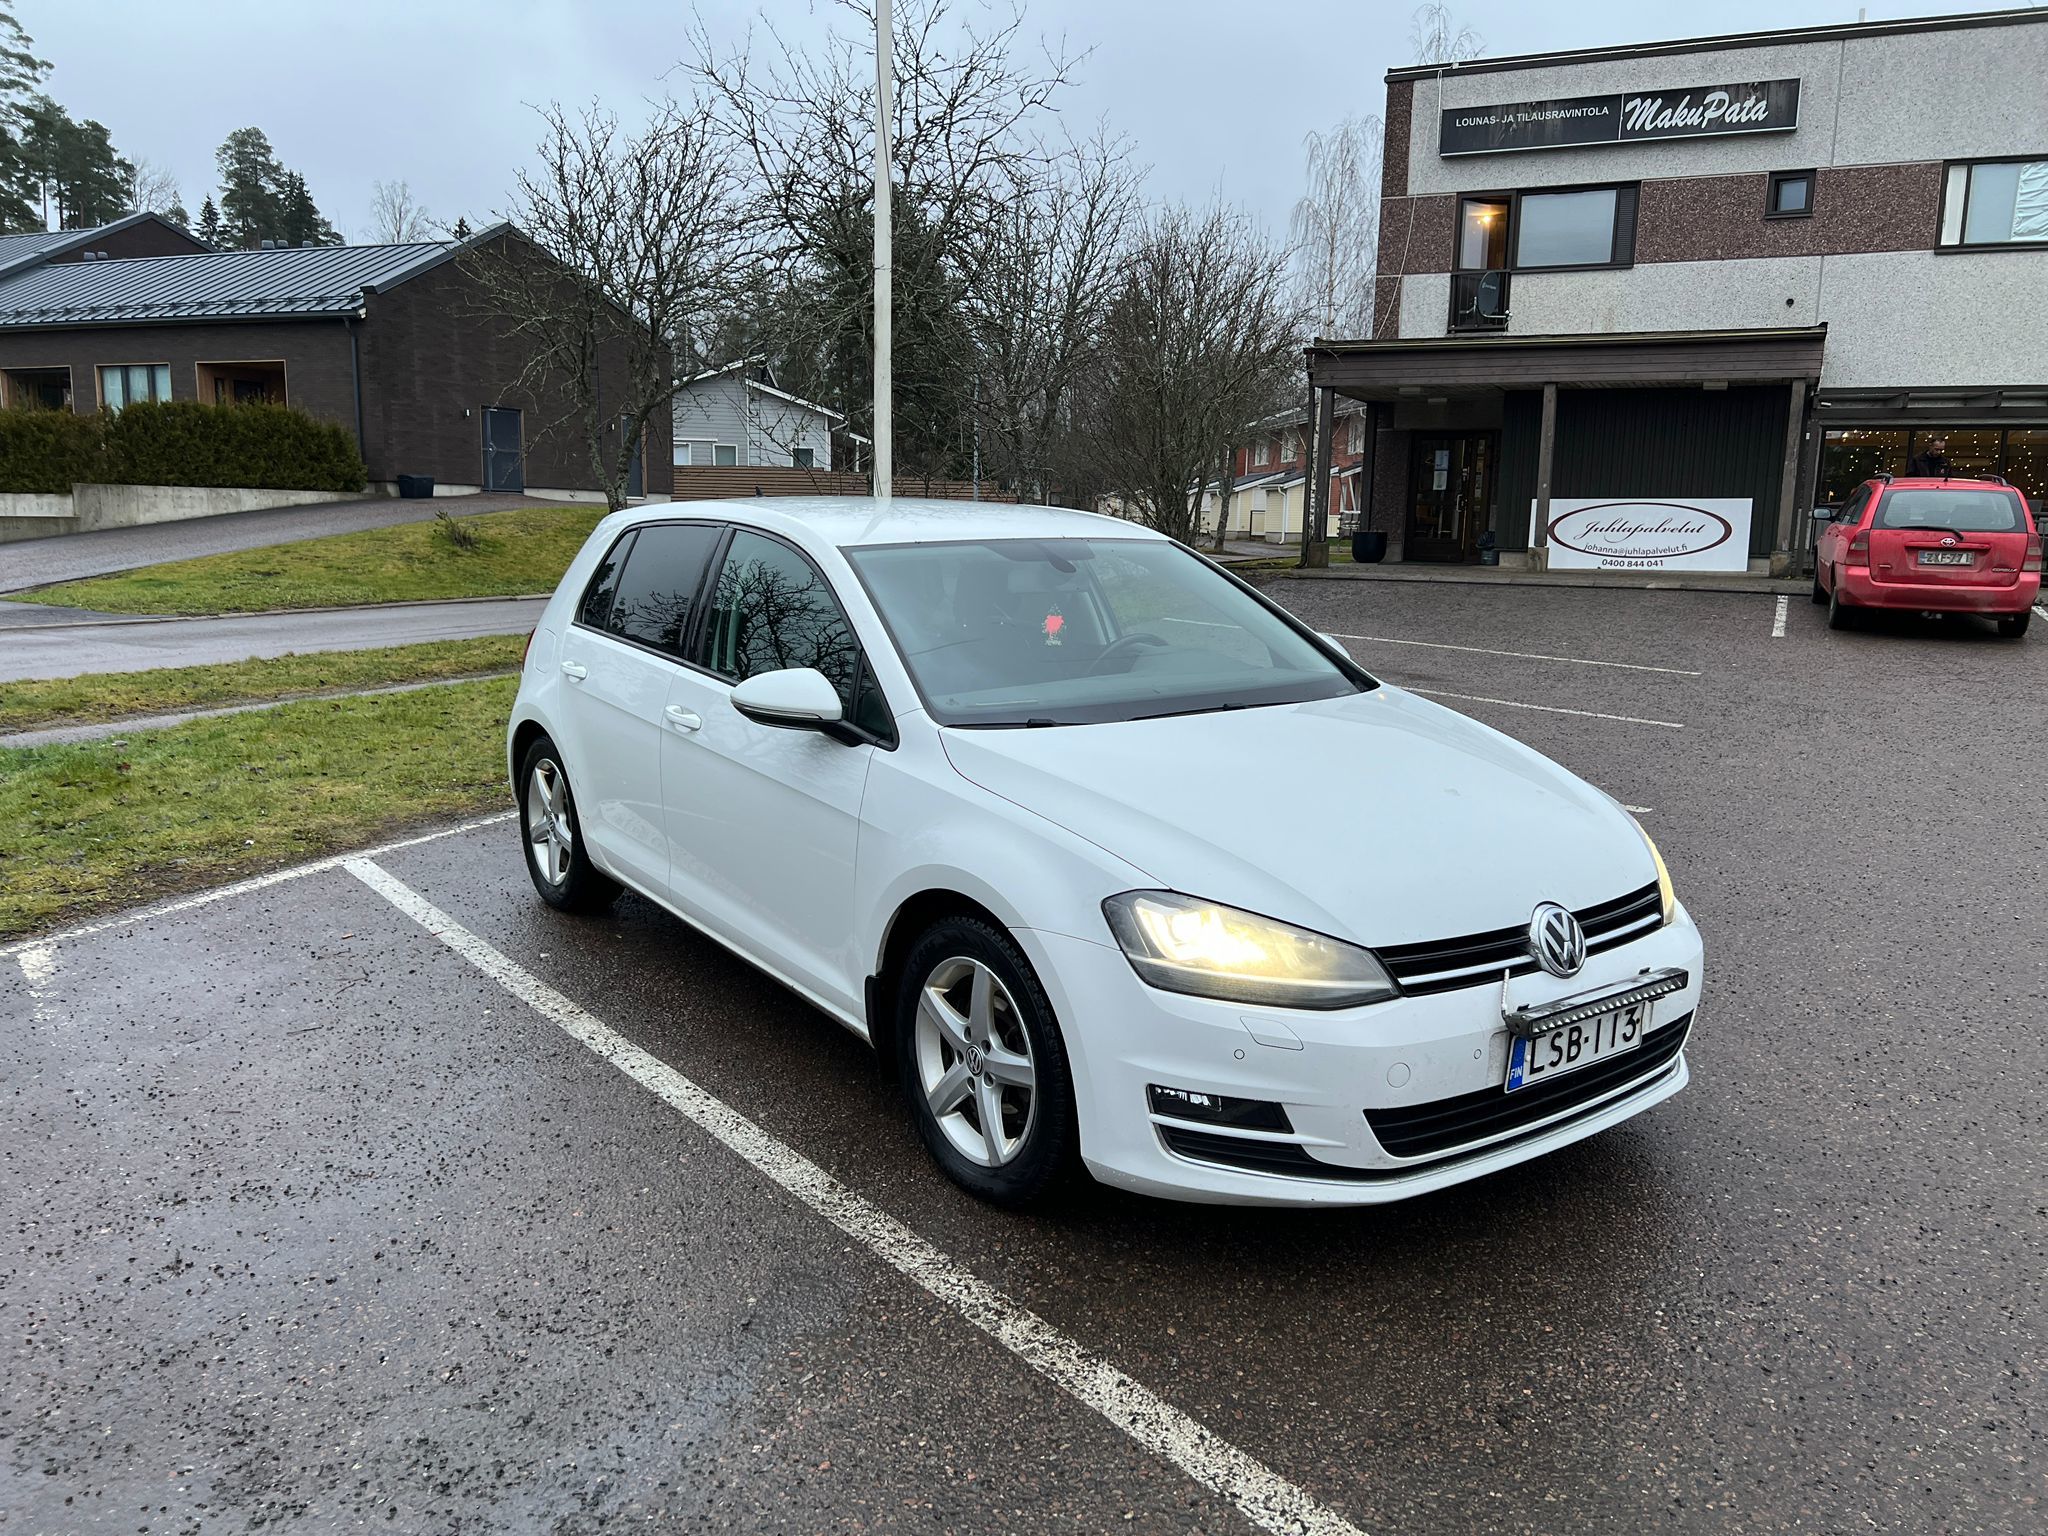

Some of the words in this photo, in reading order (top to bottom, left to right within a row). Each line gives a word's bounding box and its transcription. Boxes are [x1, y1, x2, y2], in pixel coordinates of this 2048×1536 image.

[1455, 115, 1500, 128] LOUNAS-
[1501, 113, 1514, 124] JA
[1516, 106, 1609, 123] TILAUSRAVINTOLA
[1624, 91, 1769, 132] MakuPata
[1573, 517, 1706, 543] Juhlapalvelut
[1584, 543, 1688, 557] johanna@juhlapalvelut.fi
[1601, 558, 1625, 567] 0400
[1626, 559, 1645, 568] 844
[1646, 559, 1664, 568] 041
[1529, 1006, 1639, 1075] LSB-113
[1509, 1065, 1523, 1081] FIN
